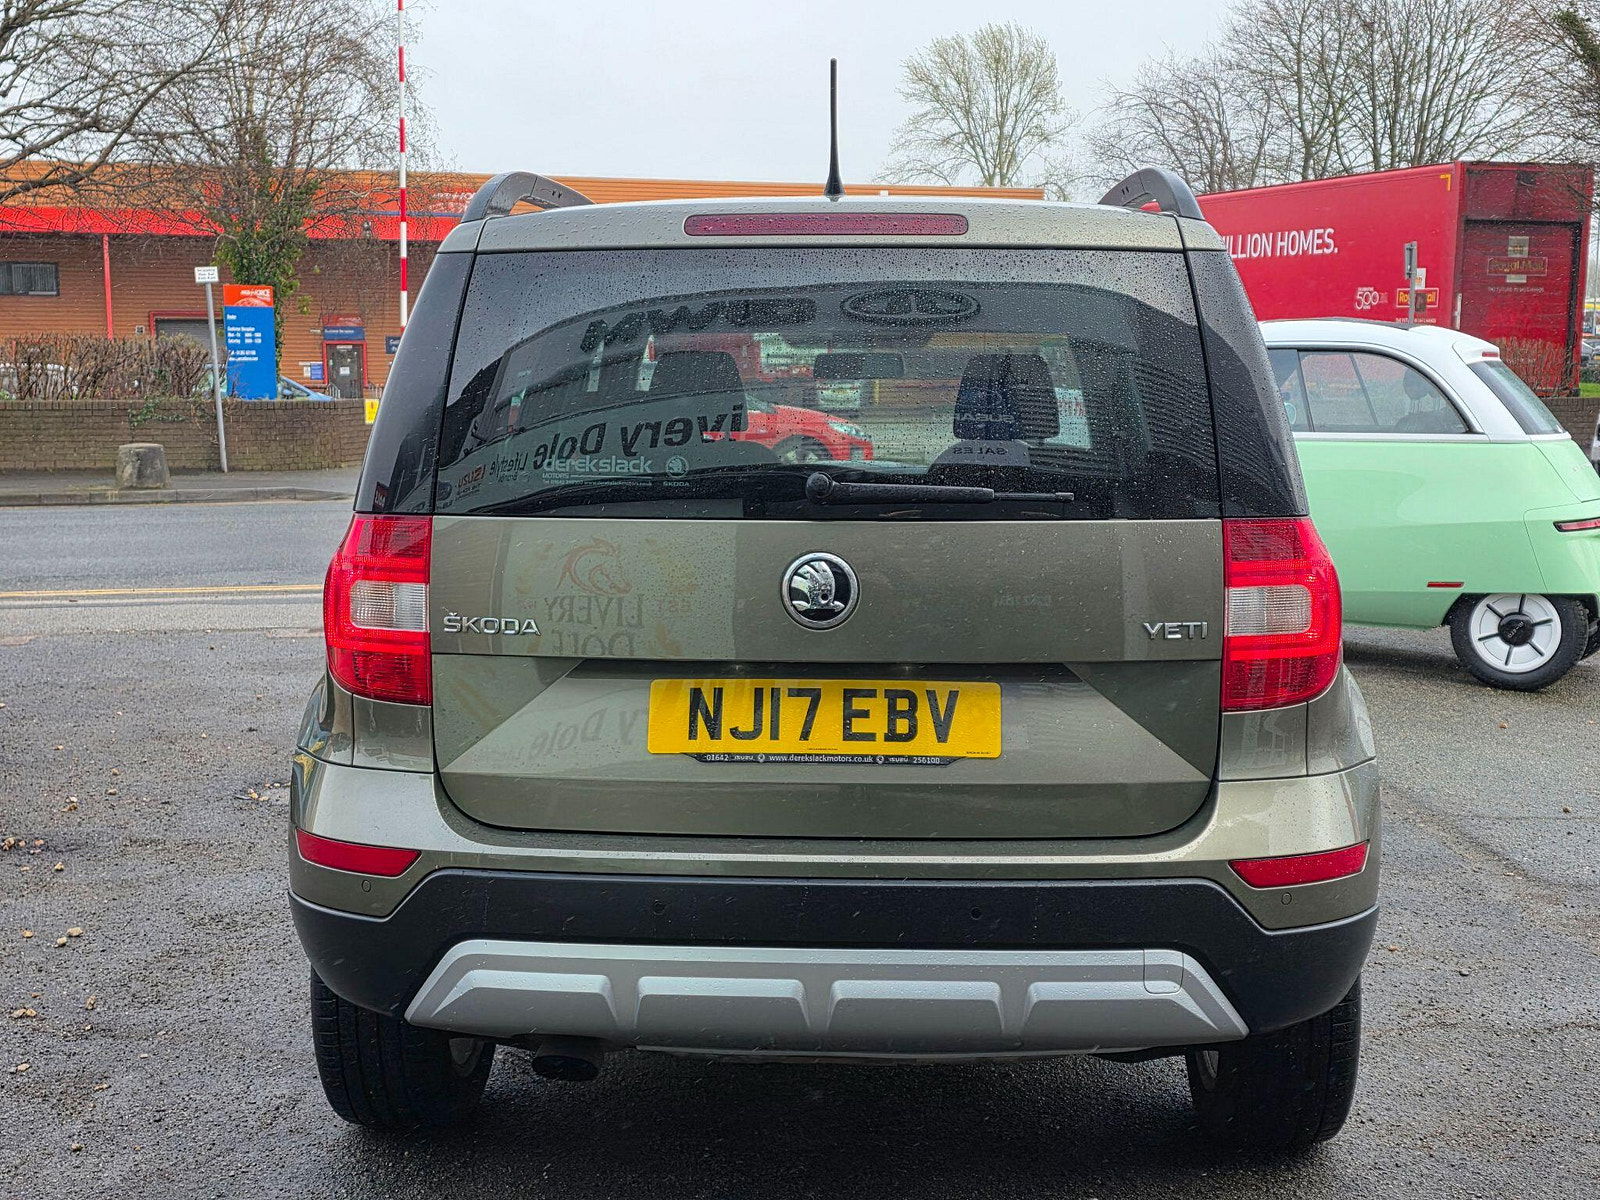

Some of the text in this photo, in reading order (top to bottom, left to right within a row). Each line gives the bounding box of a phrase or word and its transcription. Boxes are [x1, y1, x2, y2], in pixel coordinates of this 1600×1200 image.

[1276, 227, 1339, 257] HOMES.
[1355, 291, 1380, 310] 500
[443, 612, 541, 636] ŠKODA
[1143, 621, 1209, 640] YETI
[688, 686, 822, 742] NJ17
[842, 688, 960, 744] EBV
[769, 754, 873, 763] www.derekslackmotors.co.uk
